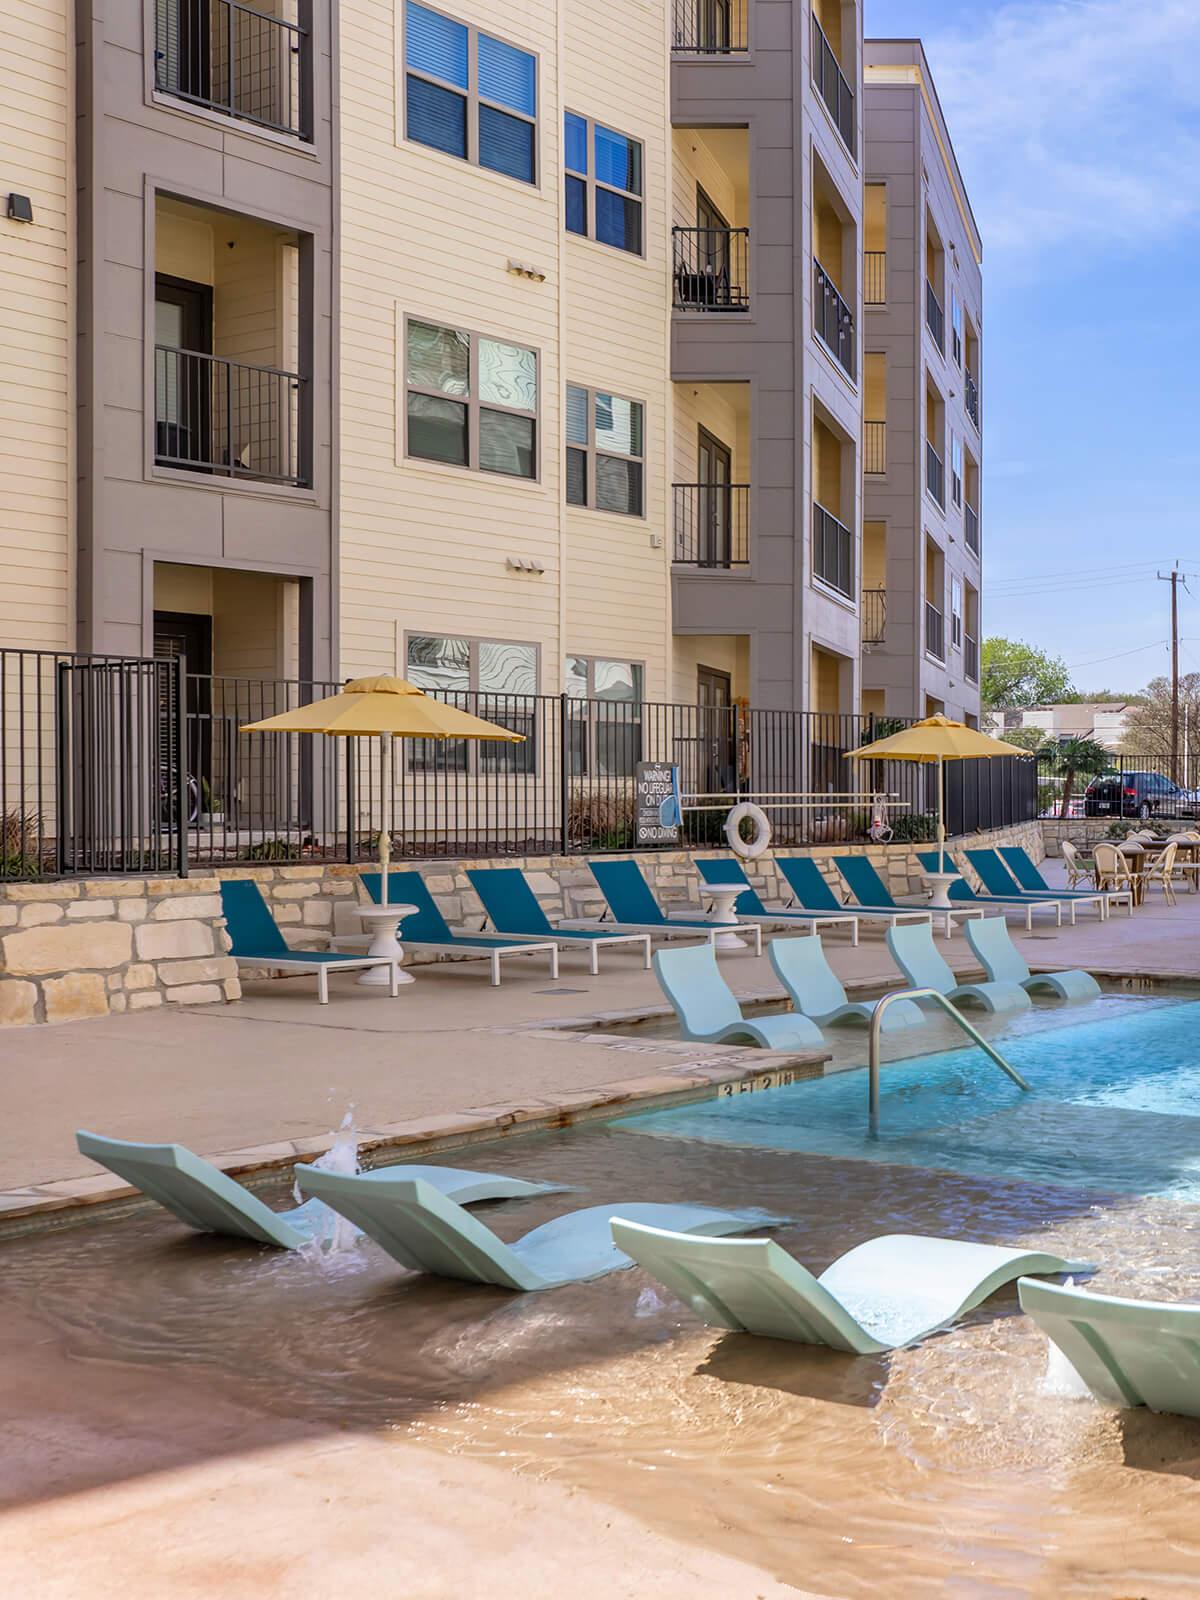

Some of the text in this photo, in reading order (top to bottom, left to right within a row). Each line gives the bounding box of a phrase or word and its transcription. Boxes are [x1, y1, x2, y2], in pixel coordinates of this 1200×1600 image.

[638, 782, 672, 794] NO LIFEGUA
[645, 795, 656, 806] ON
[648, 827, 678, 838] NO DIVING
[741, 1080, 754, 1095] FT
[763, 1076, 772, 1090] 2
